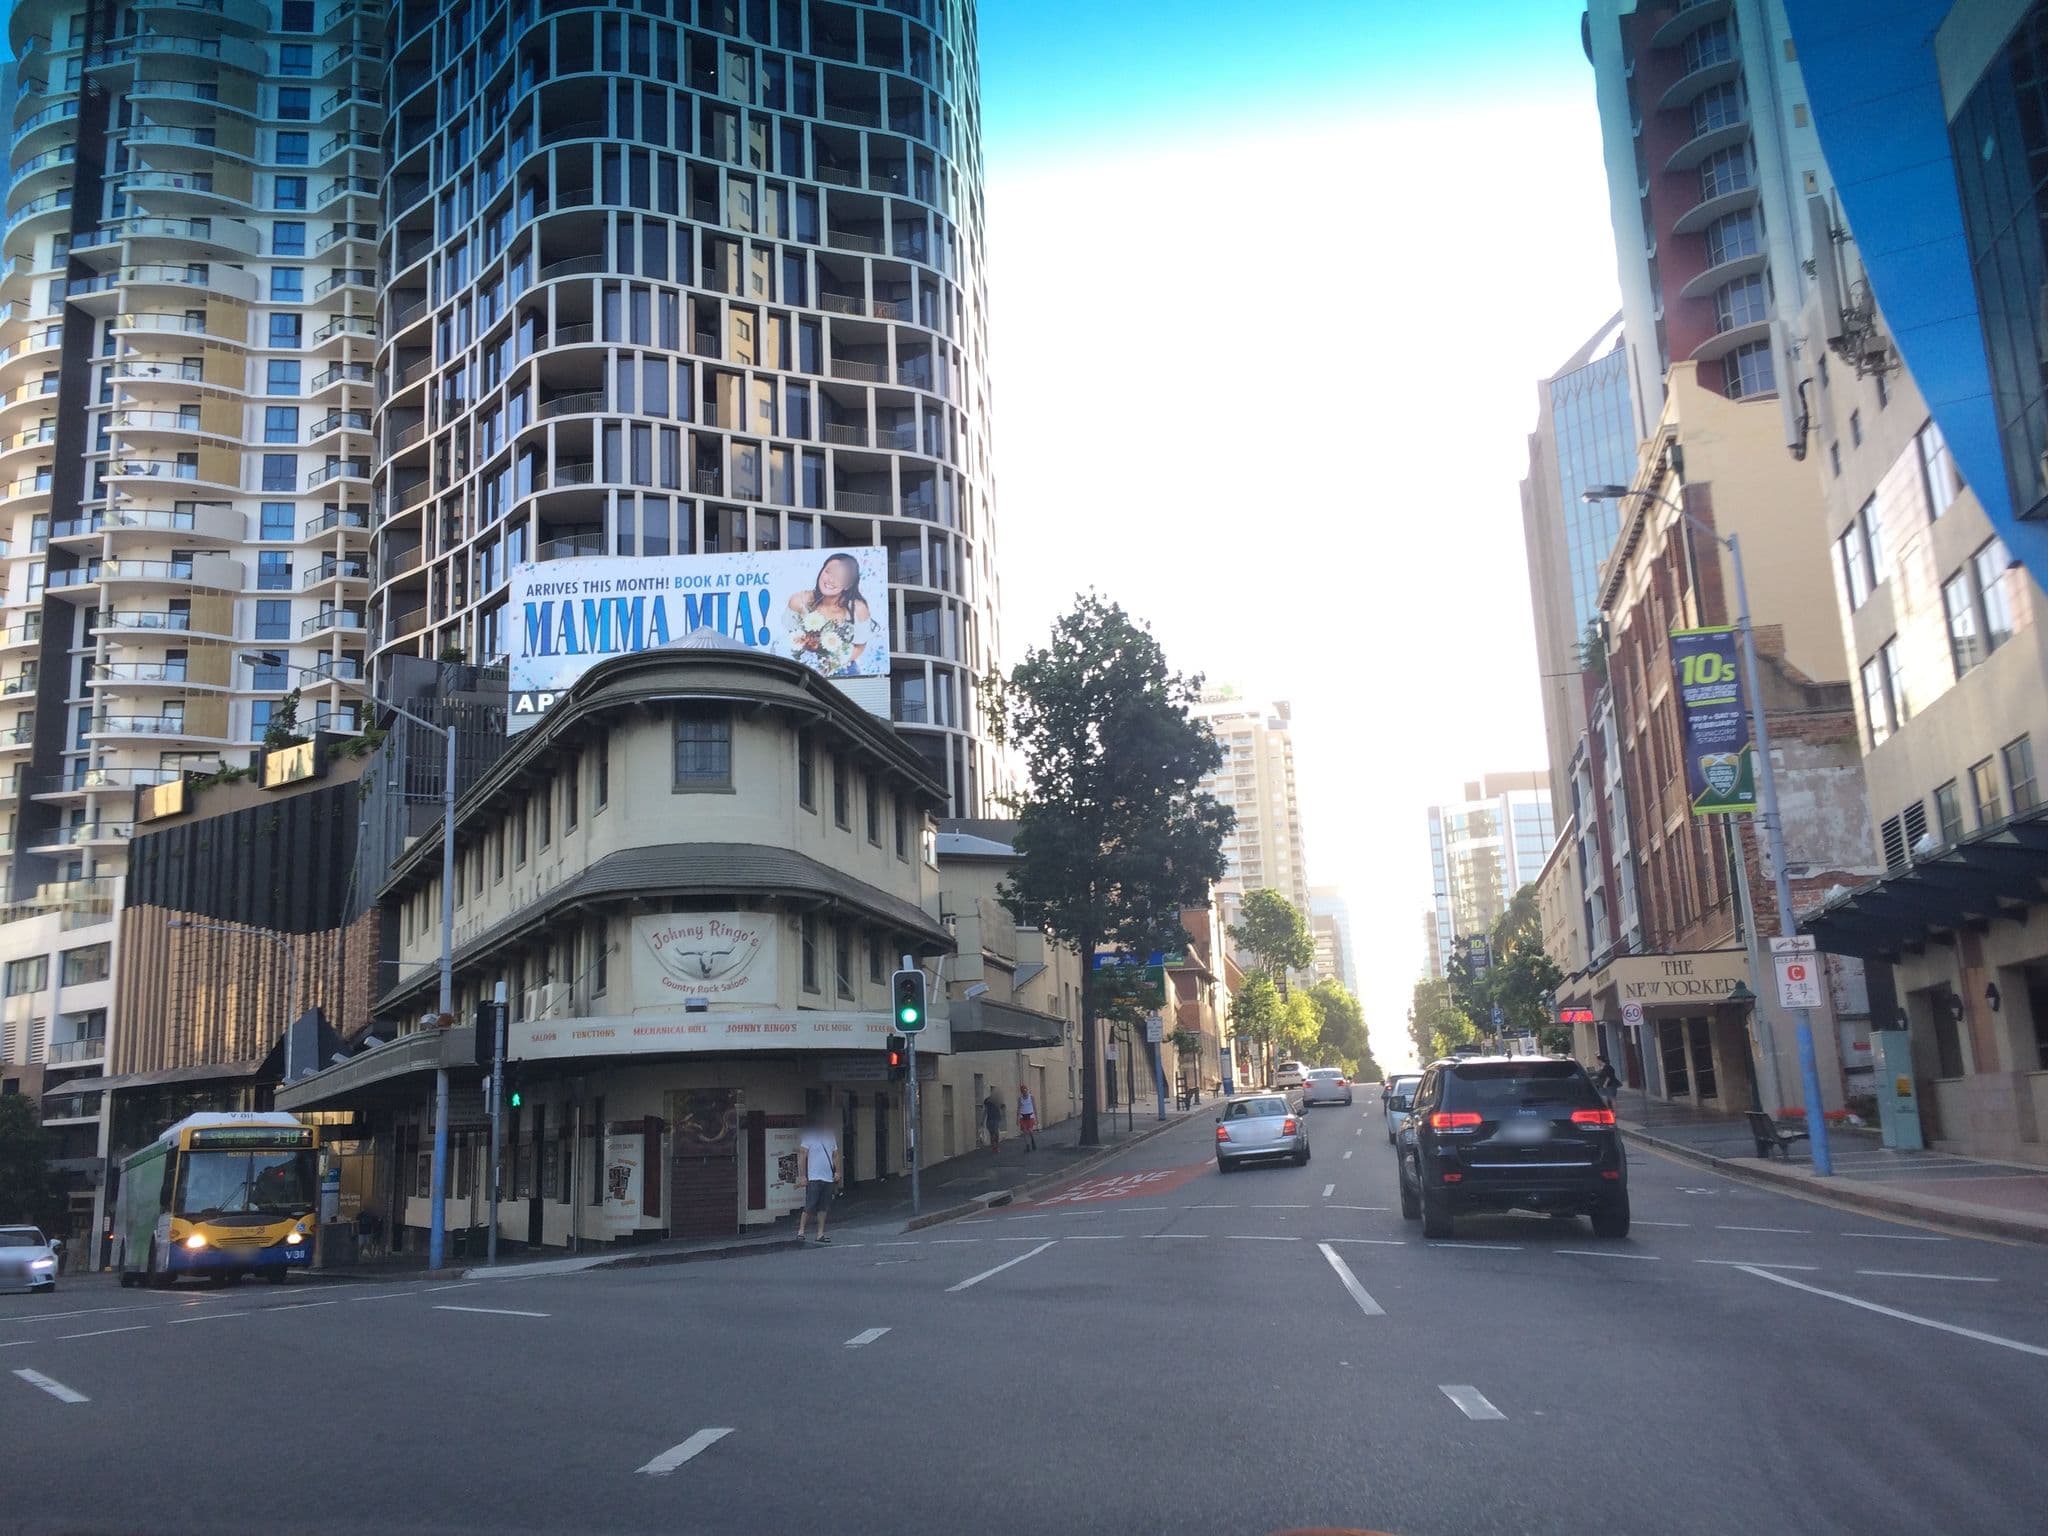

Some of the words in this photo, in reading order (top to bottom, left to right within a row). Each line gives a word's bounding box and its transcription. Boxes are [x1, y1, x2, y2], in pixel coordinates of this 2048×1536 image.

[526, 581, 579, 597] ARRIVES
[582, 580, 612, 593] THIS
[615, 577, 670, 592] MONTH!
[674, 575, 712, 589] BOOK
[715, 574, 732, 587] AT
[735, 572, 770, 587] QPAC
[521, 595, 670, 659] MAMMA
[683, 588, 771, 647] MIA!
[1679, 652, 1736, 686] 10s
[515, 691, 567, 713] AP
[652, 925, 704, 950] Johnny
[709, 920, 760, 947] Ringo's
[1661, 960, 1694, 975] THE
[1791, 966, 1802, 980] C
[661, 976, 696, 994] Country
[697, 984, 720, 993] Rock
[721, 976, 749, 992] Saloon
[1625, 981, 1660, 998] NEW
[1625, 1008, 1640, 1018] 60
[572, 1029, 616, 1040] FUNCTIONS
[725, 1024, 762, 1033] JOHNNY
